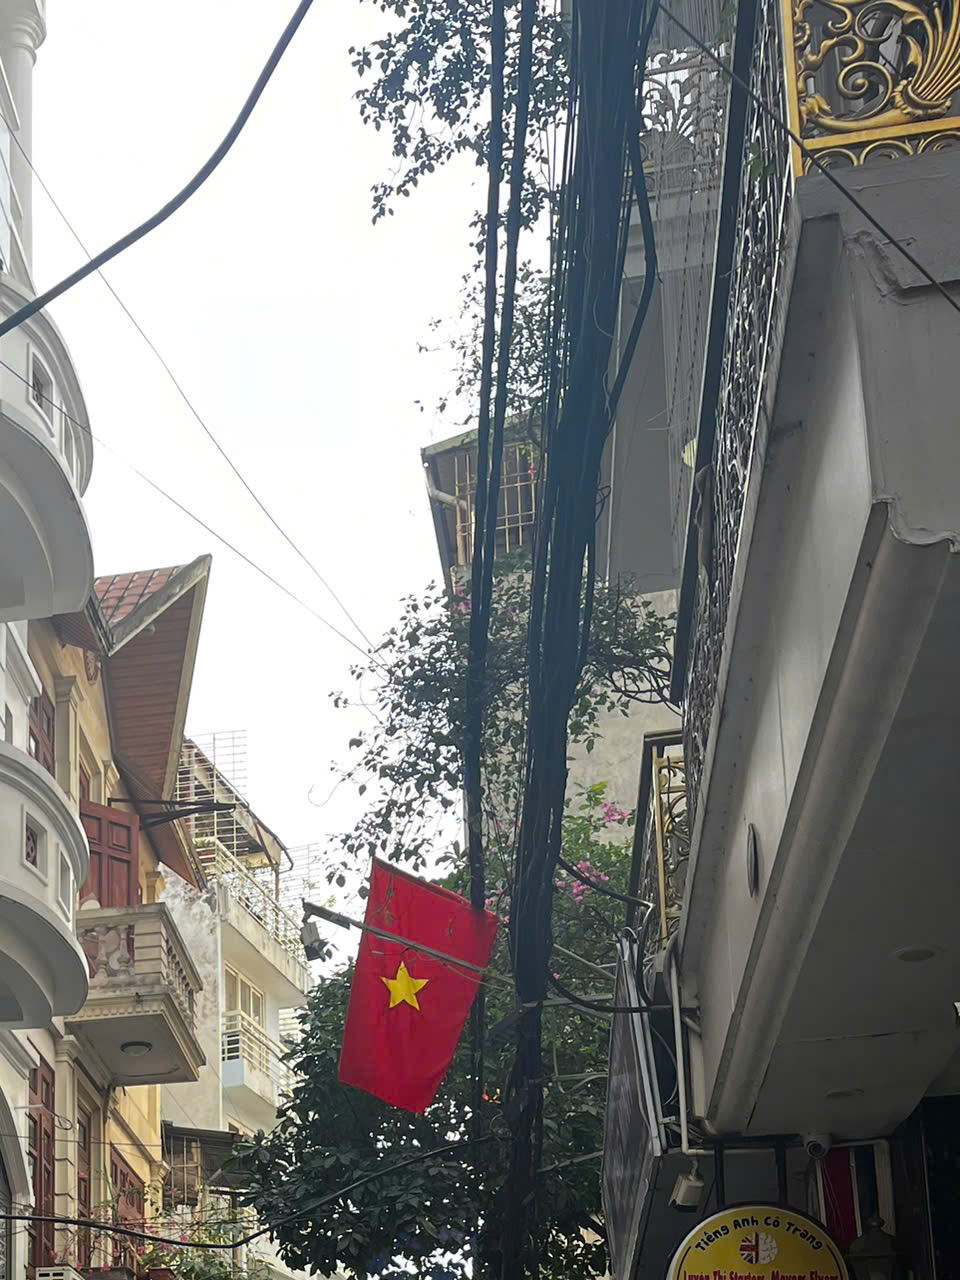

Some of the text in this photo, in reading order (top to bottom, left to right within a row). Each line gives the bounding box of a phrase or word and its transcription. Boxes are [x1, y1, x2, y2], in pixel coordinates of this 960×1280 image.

[733, 1215, 759, 1231] Anh
[763, 1215, 781, 1228] Cô
[785, 1222, 824, 1250] Trang
